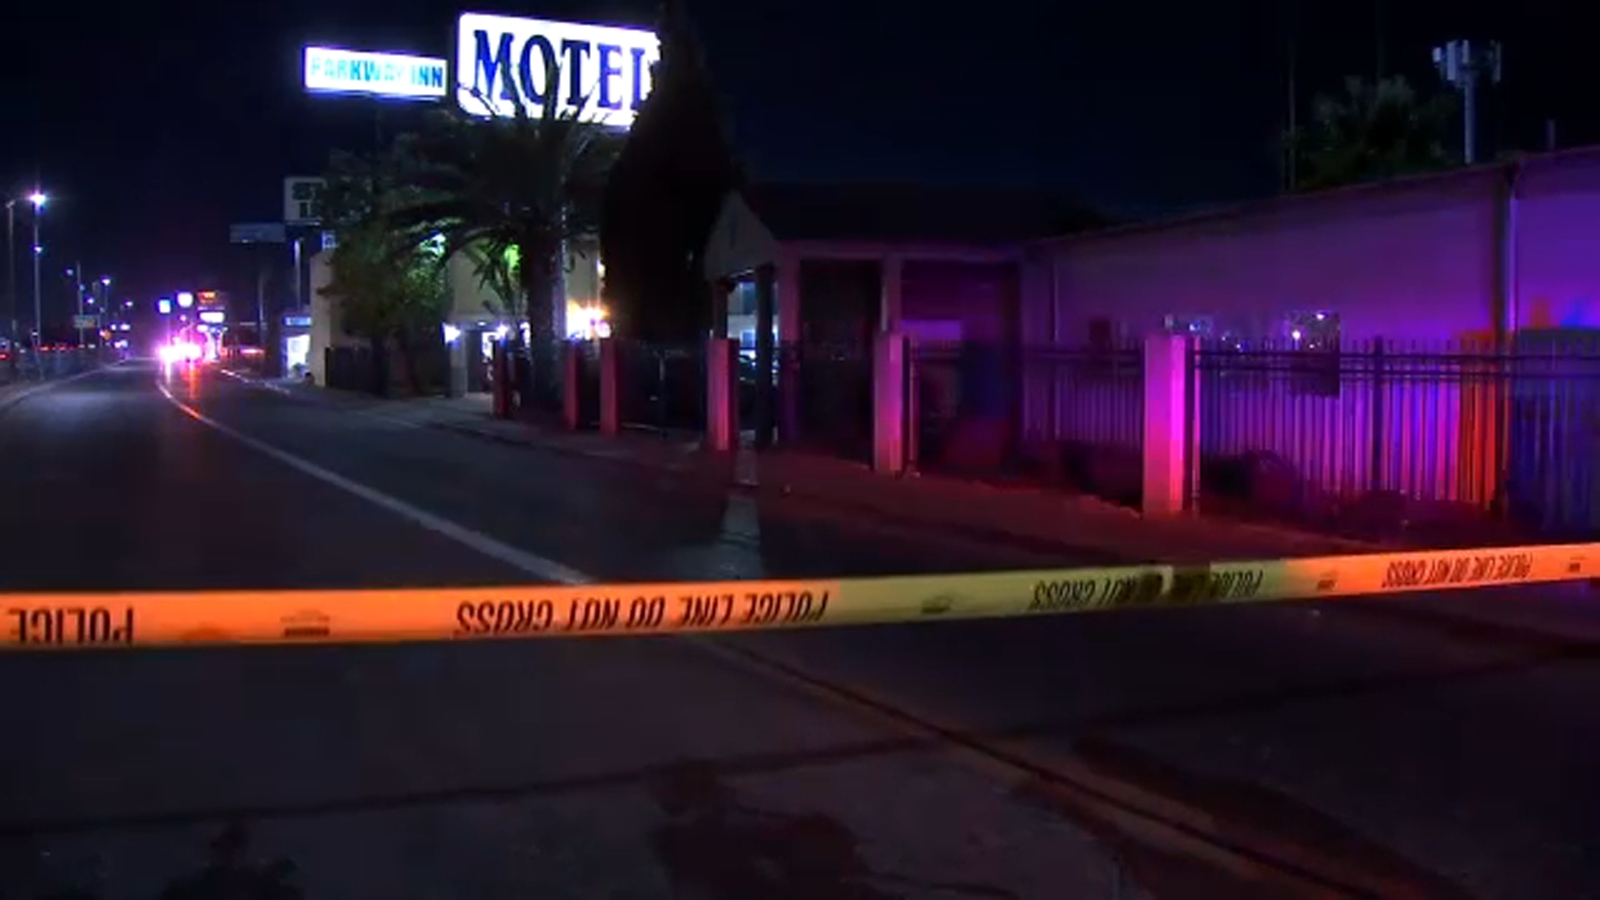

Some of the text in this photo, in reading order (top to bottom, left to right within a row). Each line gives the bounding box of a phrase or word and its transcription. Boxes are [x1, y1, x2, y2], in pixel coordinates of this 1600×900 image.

[310, 56, 443, 88] PARKWAY INN
[8, 607, 134, 645] POLICE
[453, 591, 829, 637] POLICE LINE DO NOT CROSS
